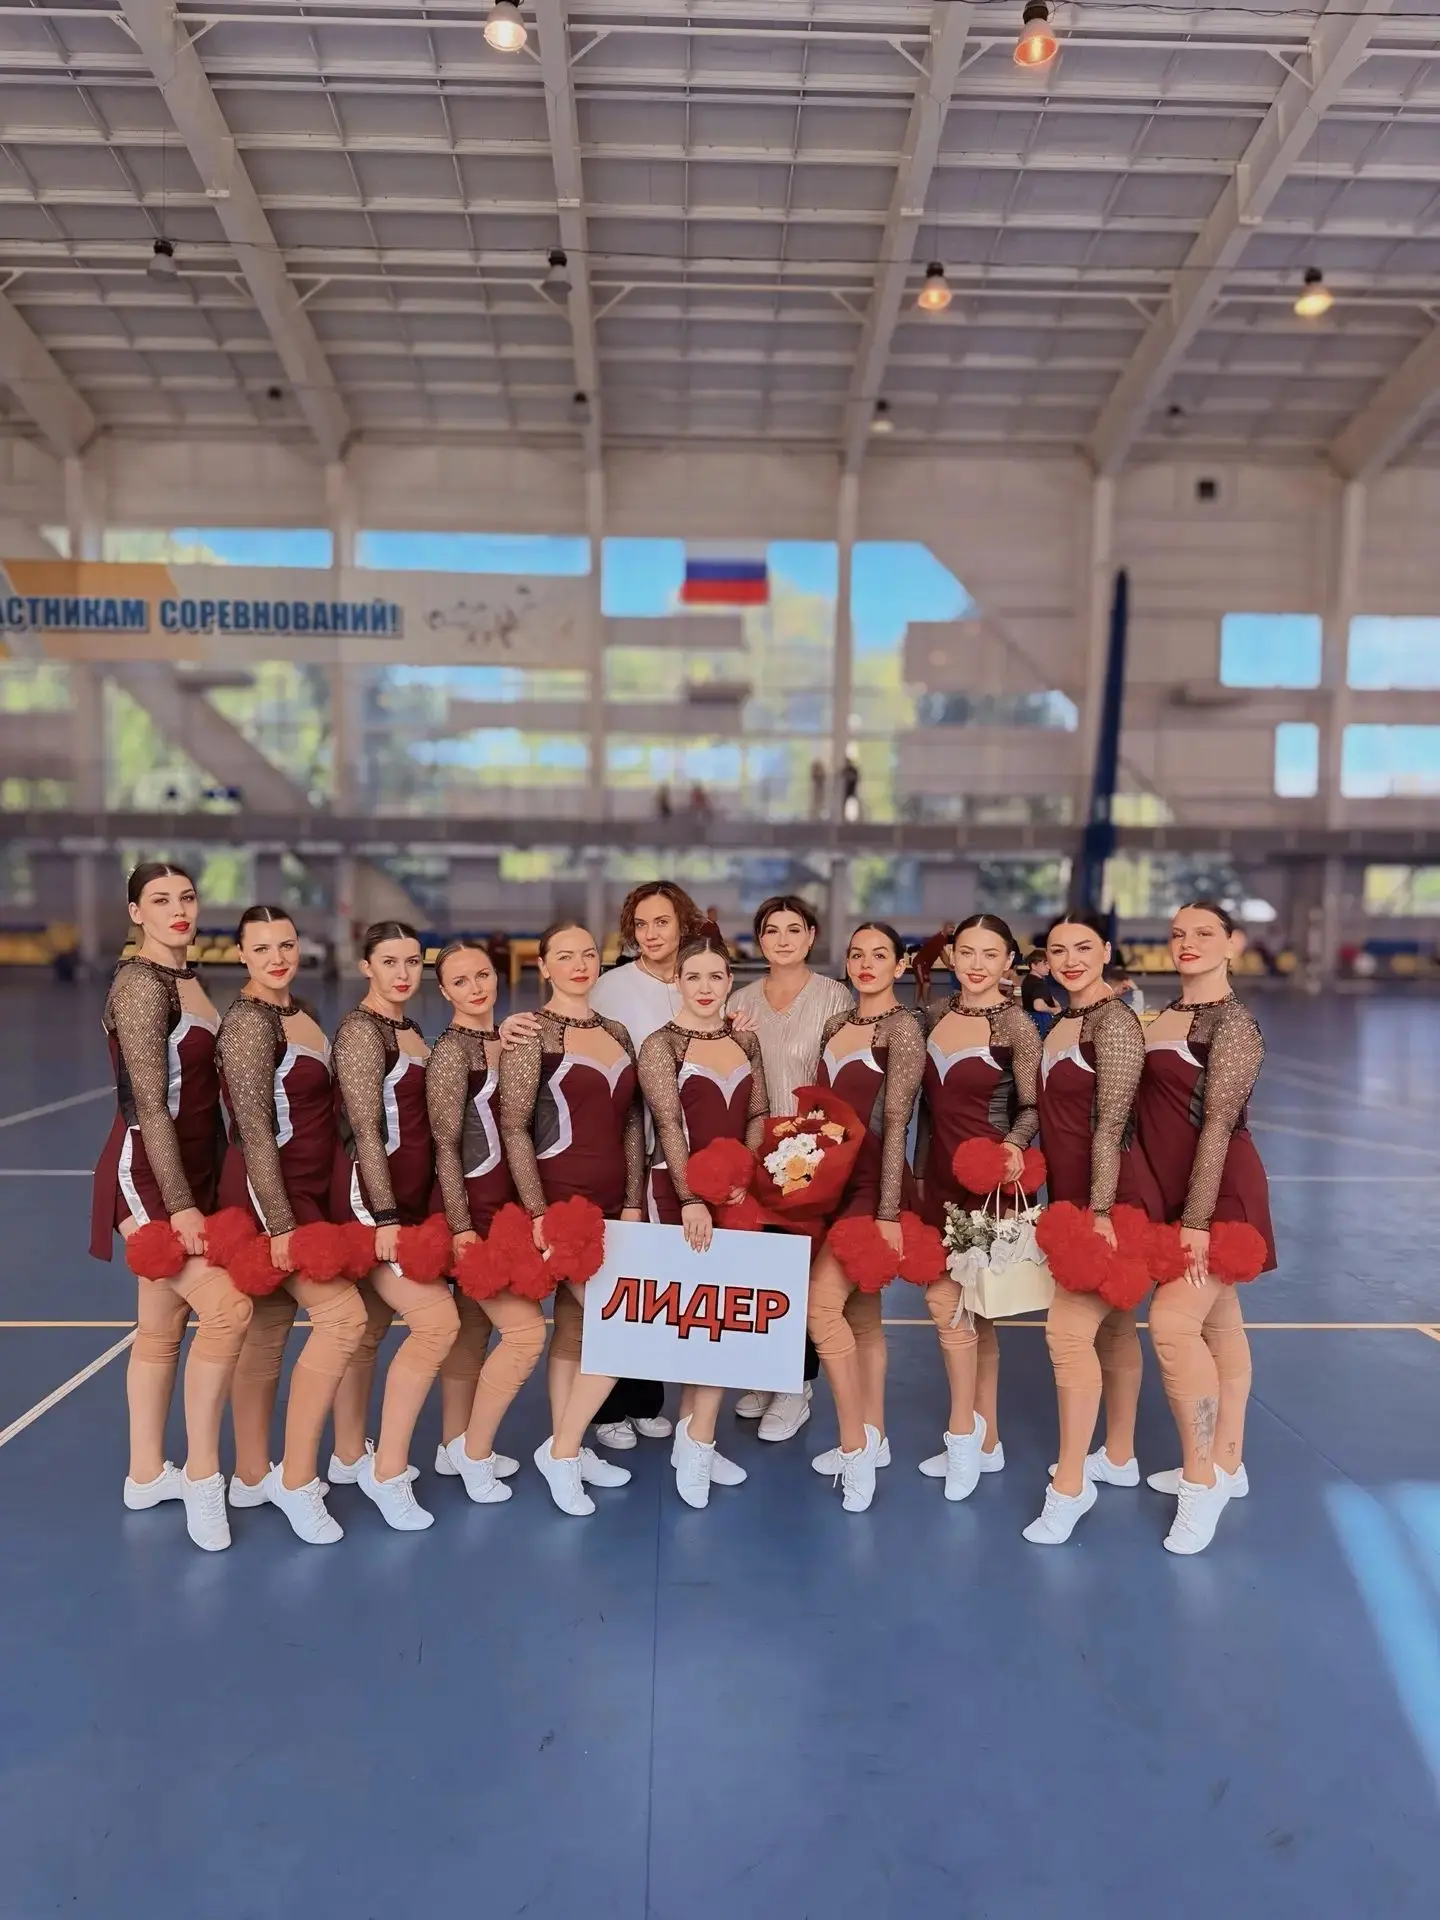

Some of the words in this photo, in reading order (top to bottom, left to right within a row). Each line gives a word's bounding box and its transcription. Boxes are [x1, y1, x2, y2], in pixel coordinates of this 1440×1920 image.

[0, 597, 145, 628] СТНИКАМ
[159, 598, 399, 632] СОРЕВНОВАНИЙ!
[601, 1277, 790, 1342] ЛИДЕР
